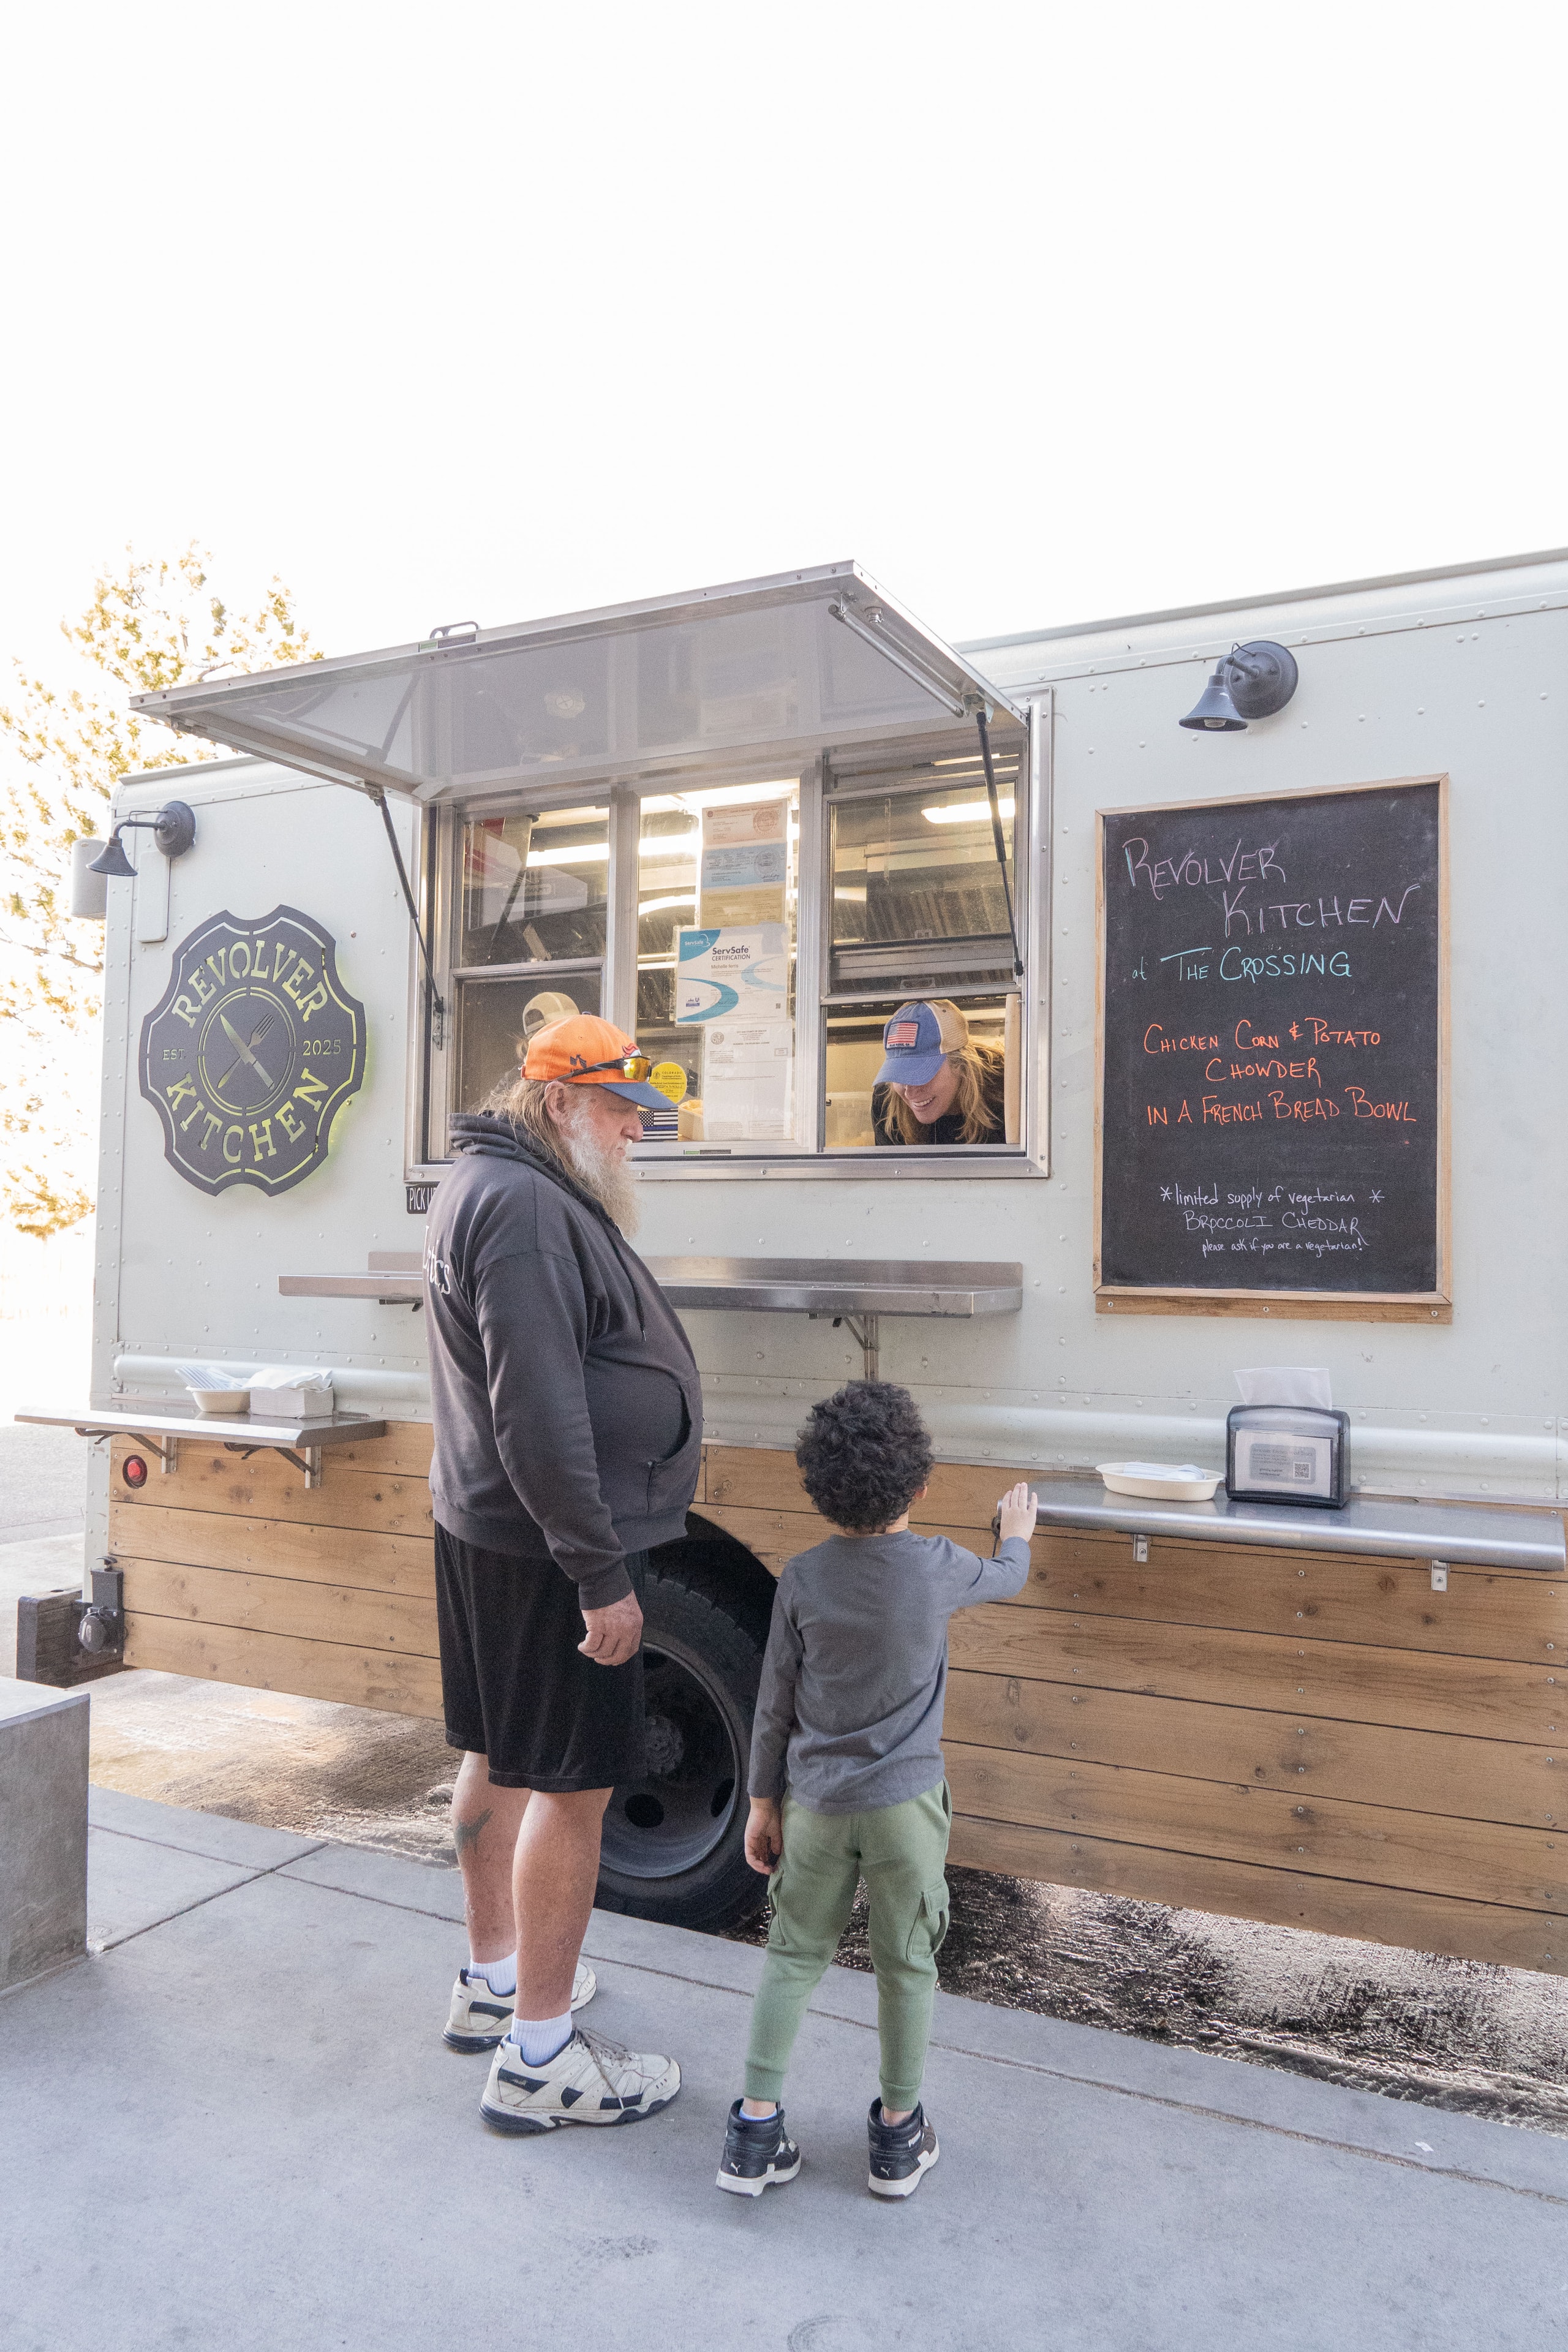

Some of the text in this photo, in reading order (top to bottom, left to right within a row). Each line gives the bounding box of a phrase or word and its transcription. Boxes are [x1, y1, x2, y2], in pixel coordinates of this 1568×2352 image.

[1122, 838, 1286, 900] REVOLVER
[1223, 884, 1420, 938] KITCHEN
[712, 946, 749, 954] ServSafe
[1133, 957, 1147, 980] at
[1220, 947, 1352, 983] CROSSING
[172, 940, 328, 1028] REVOLVER
[162, 1039, 342, 1061] EST. 2025
[1144, 1023, 1218, 1054] CHICKEN
[1235, 1019, 1280, 1050] CORN
[1305, 1017, 1381, 1048] POTATO
[1205, 1058, 1321, 1088] CHOWDER
[166, 1068, 329, 1163] KITCHEN
[1147, 1087, 1417, 1126] IN A FRENCH BREAD BOWL
[409, 1187, 425, 1210] PICK
[1227, 1186, 1262, 1210] supply
[1268, 1185, 1284, 1202] of
[1288, 1187, 1355, 1215] vegetarian
[1282, 1212, 1370, 1246] CHEDDAR
[1202, 1238, 1225, 1258] please
[1231, 1238, 1248, 1251] ask
[1250, 1237, 1260, 1251] if
[1261, 1243, 1274, 1256] you
